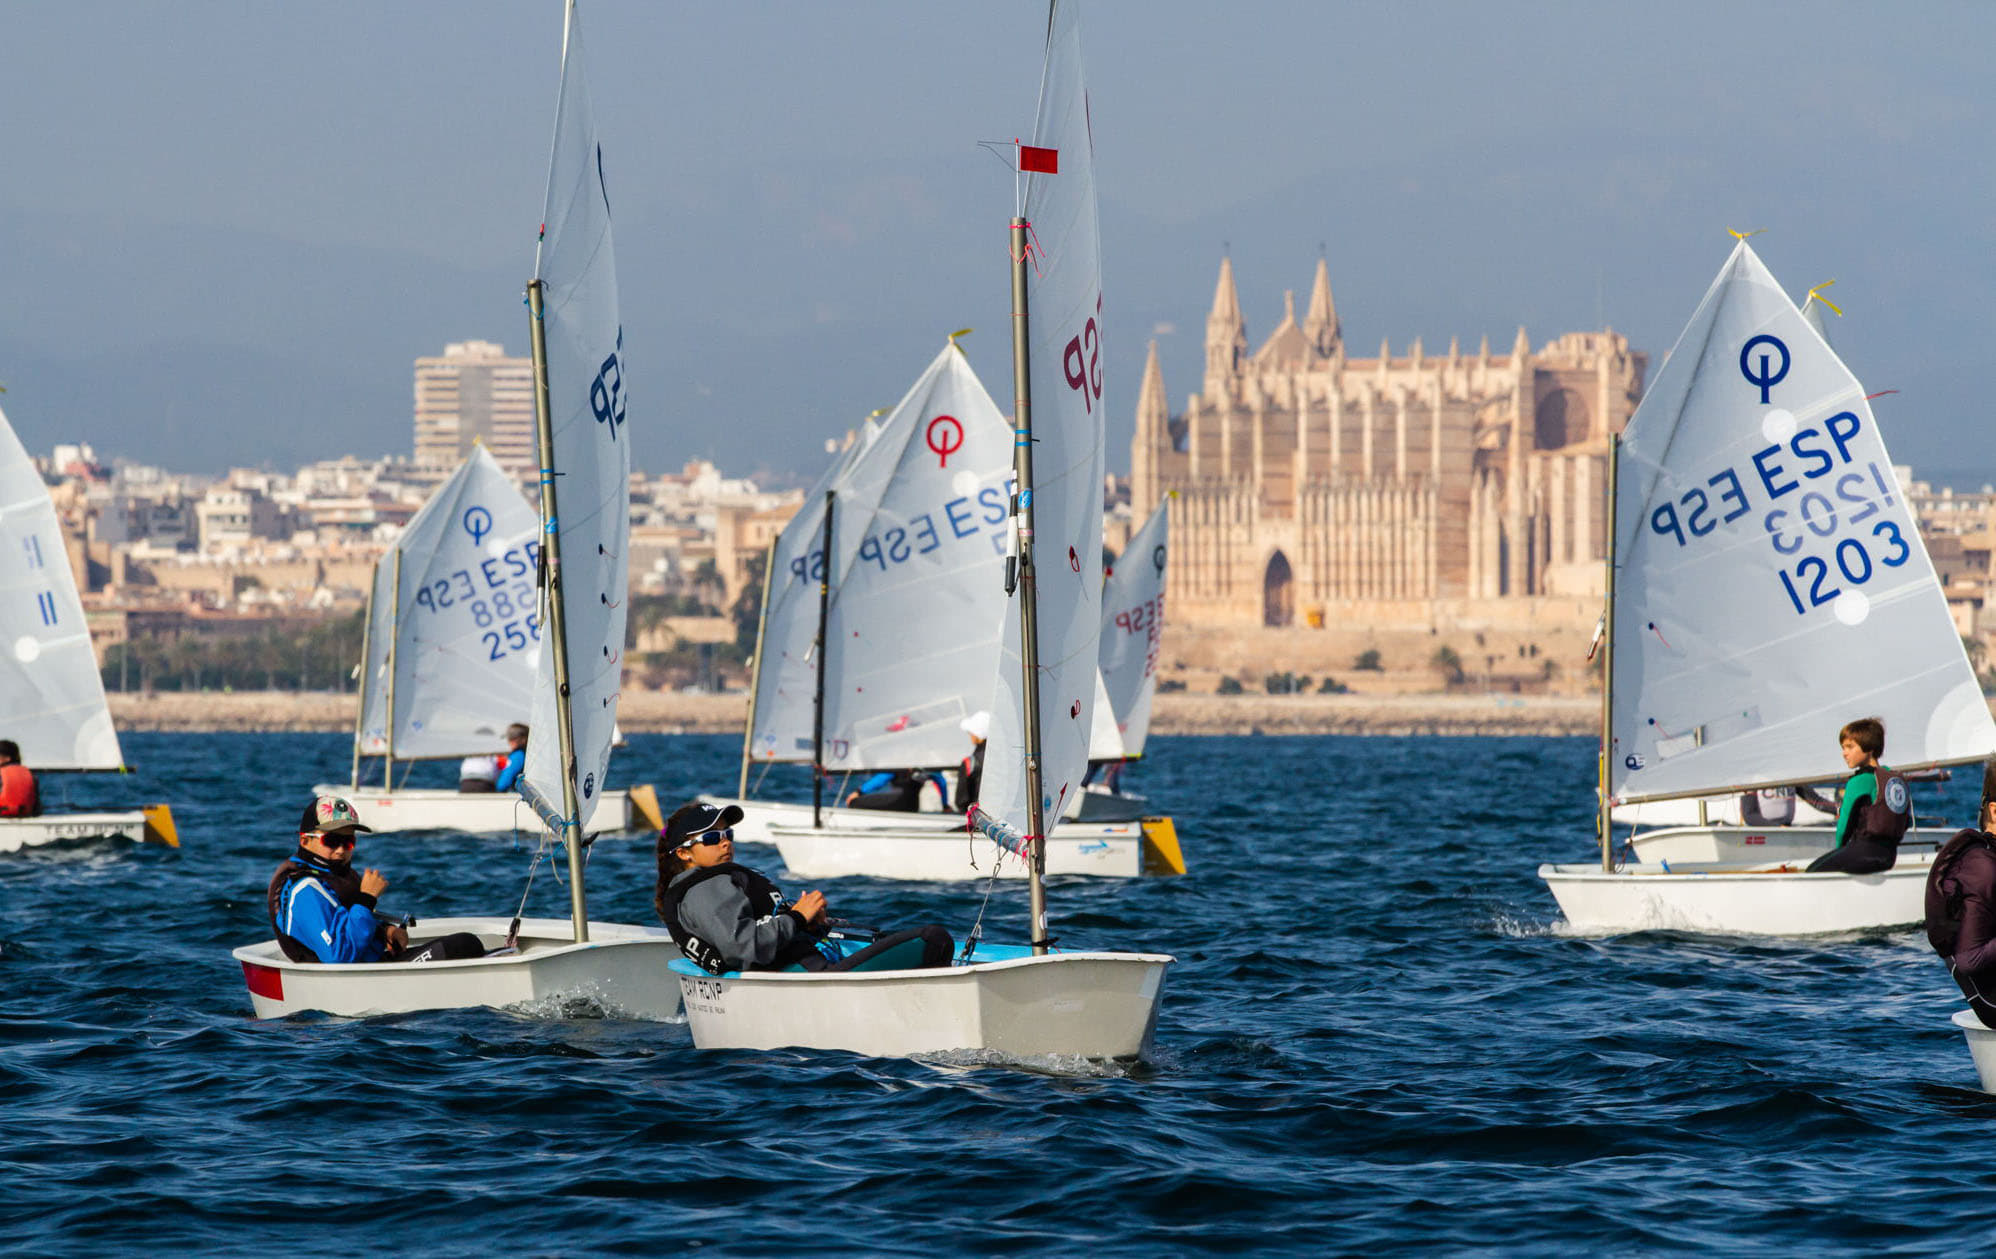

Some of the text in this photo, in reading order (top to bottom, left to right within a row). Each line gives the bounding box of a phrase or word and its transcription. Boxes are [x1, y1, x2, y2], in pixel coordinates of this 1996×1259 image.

[1752, 411, 1861, 500] ESP
[944, 480, 1012, 539] ES
[1779, 520, 1910, 615] 1203
